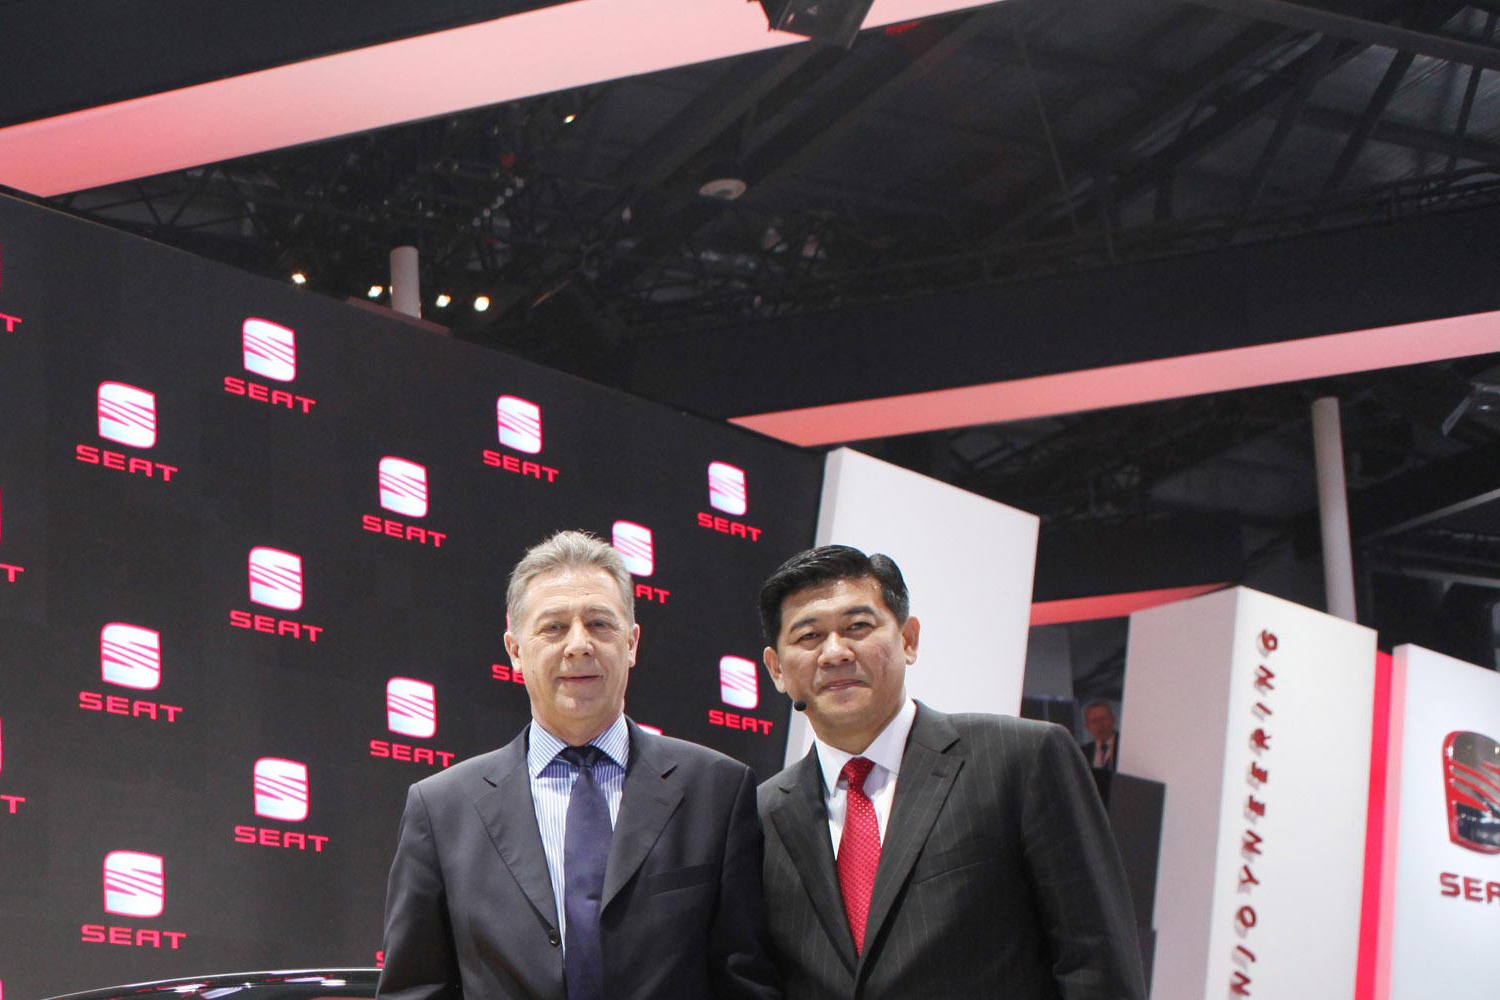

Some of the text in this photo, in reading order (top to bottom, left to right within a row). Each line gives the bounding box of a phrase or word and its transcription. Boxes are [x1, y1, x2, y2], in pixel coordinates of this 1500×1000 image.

[223, 376, 316, 414] SEAT
[76, 444, 179, 481] SEAT
[482, 449, 560, 482] SEAT
[362, 514, 448, 547] SEAT
[697, 512, 763, 542] SEAT
[635, 584, 672, 606] AT
[229, 609, 324, 642] SEAT
[491, 664, 526, 686] SE
[78, 691, 184, 723] SEAT
[708, 709, 774, 735] SEAT
[369, 740, 456, 768] SEAT
[234, 825, 330, 852] SEAT
[1440, 872, 1500, 905] SEA
[80, 924, 188, 950] SEAT
